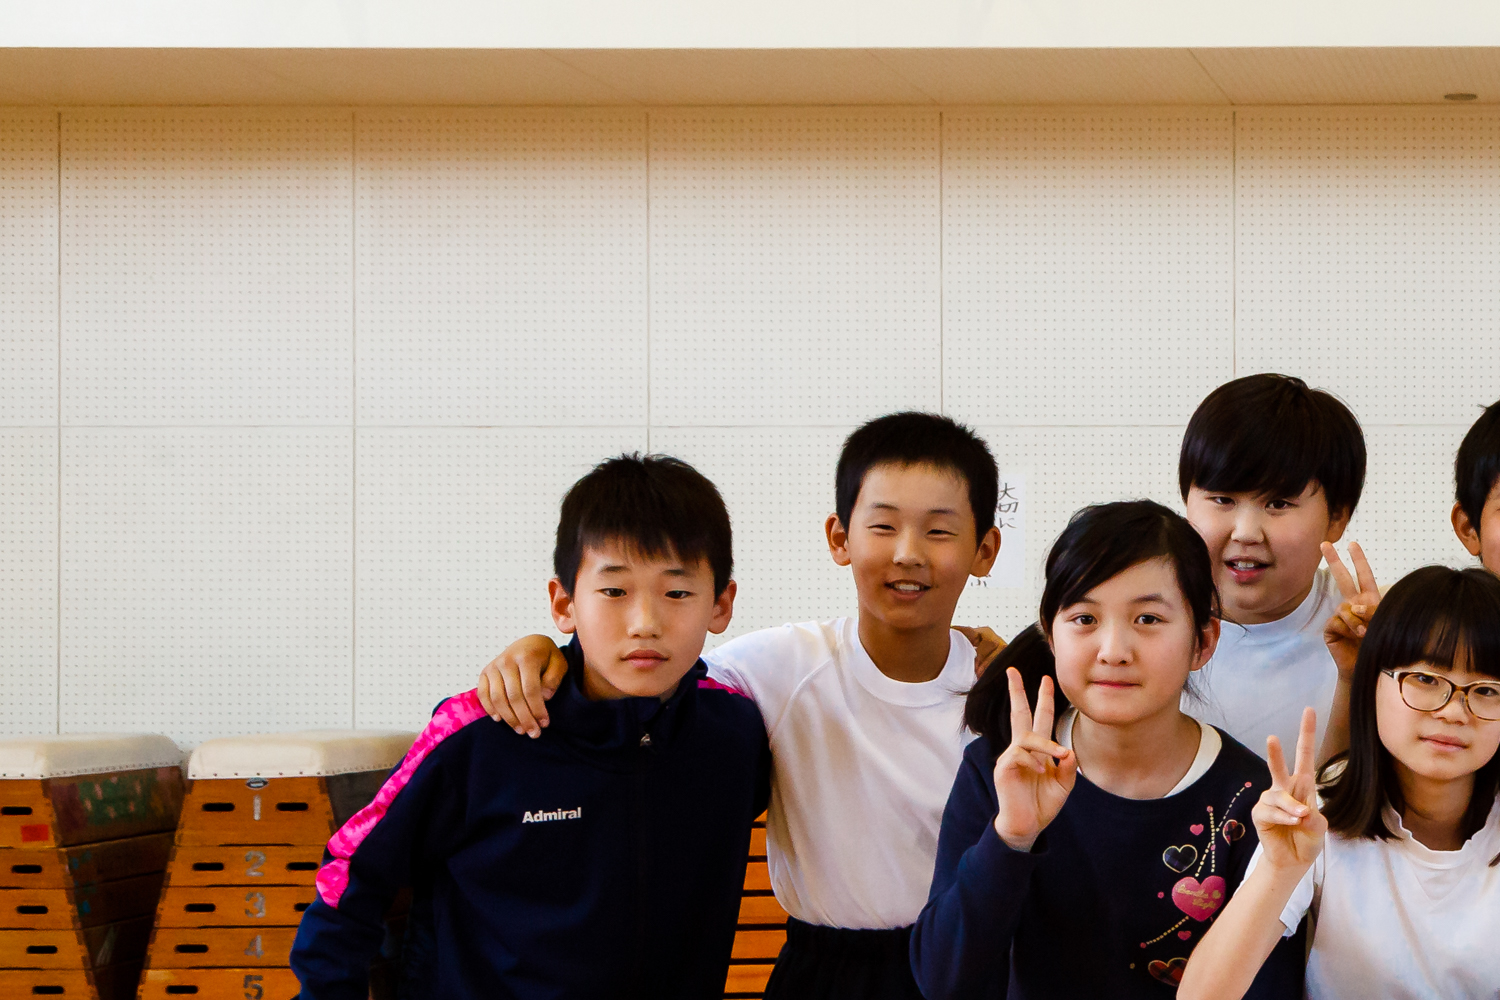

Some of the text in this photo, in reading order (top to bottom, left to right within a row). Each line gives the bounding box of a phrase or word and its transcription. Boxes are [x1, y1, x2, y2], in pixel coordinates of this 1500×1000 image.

[522, 807, 582, 823] Admiral
[244, 850, 266, 877] 2
[244, 892, 266, 918] 3
[244, 934, 264, 959] 4
[243, 974, 264, 1000] 5
